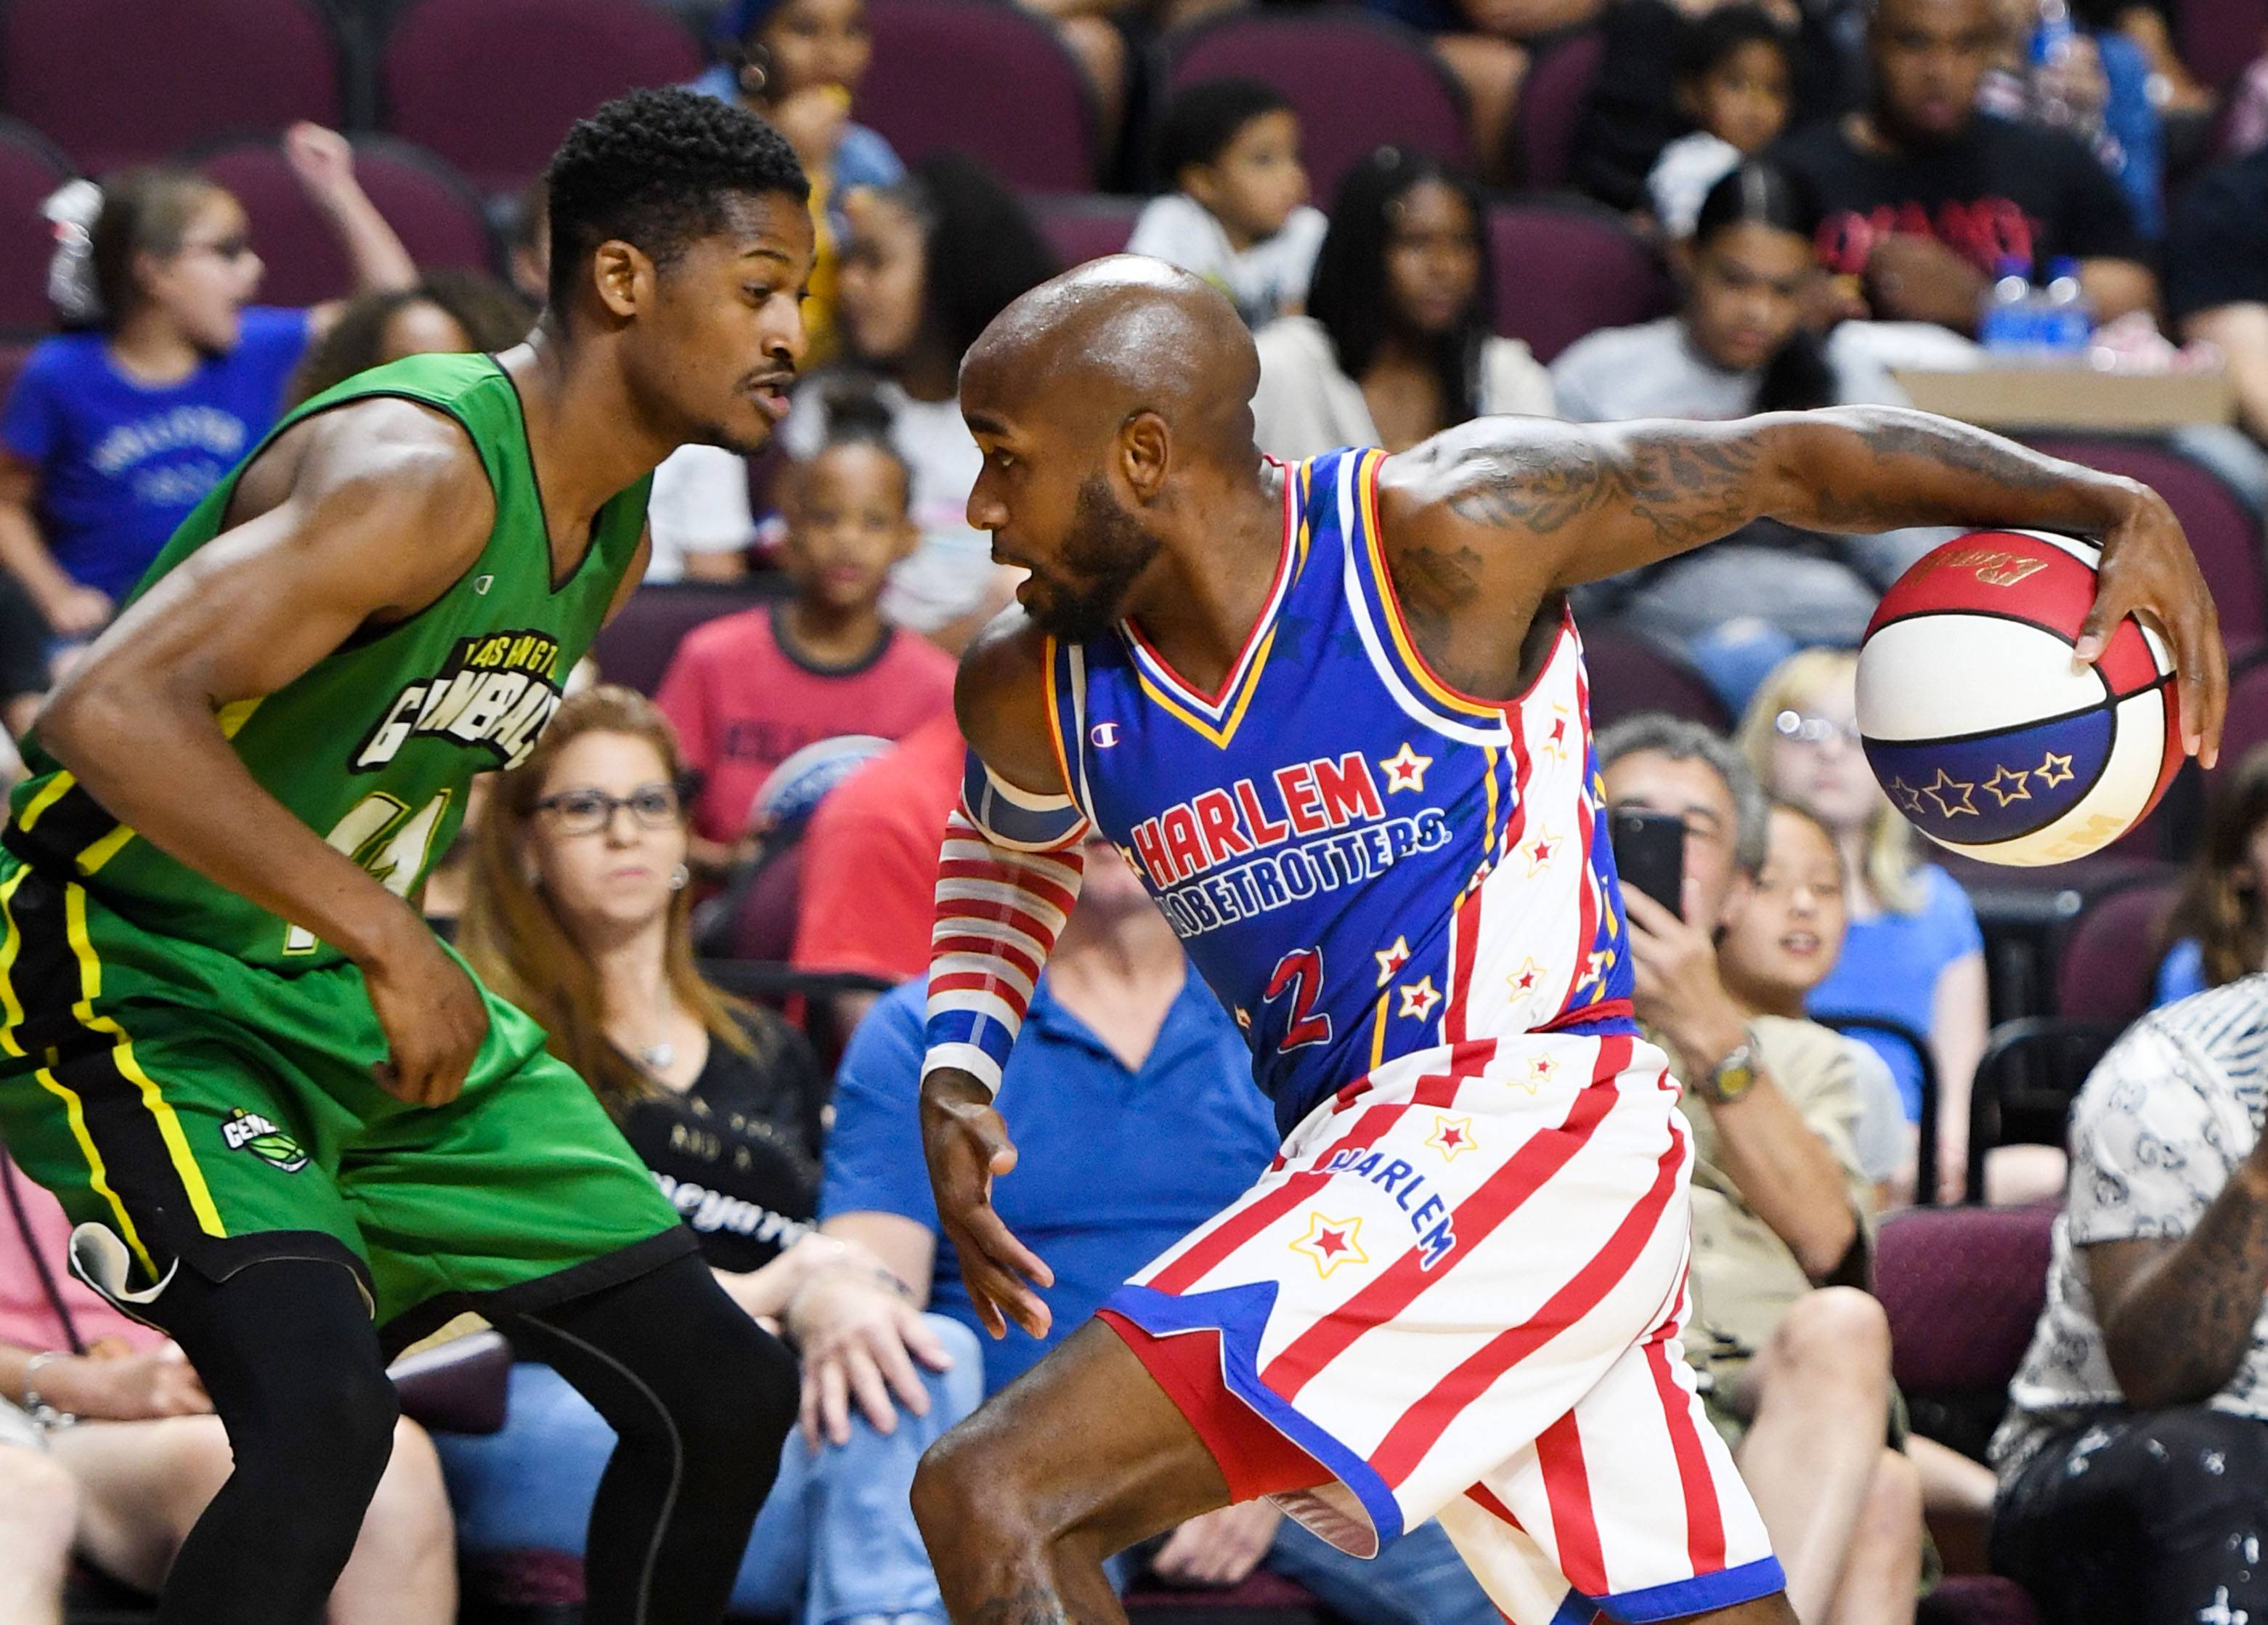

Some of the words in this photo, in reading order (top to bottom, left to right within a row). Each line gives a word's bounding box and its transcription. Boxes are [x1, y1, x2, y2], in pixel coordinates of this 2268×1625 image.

[1131, 751, 1386, 891] HARLEM
[1263, 945, 1333, 1054] 2
[1309, 1146, 1456, 1272] HARLEM
